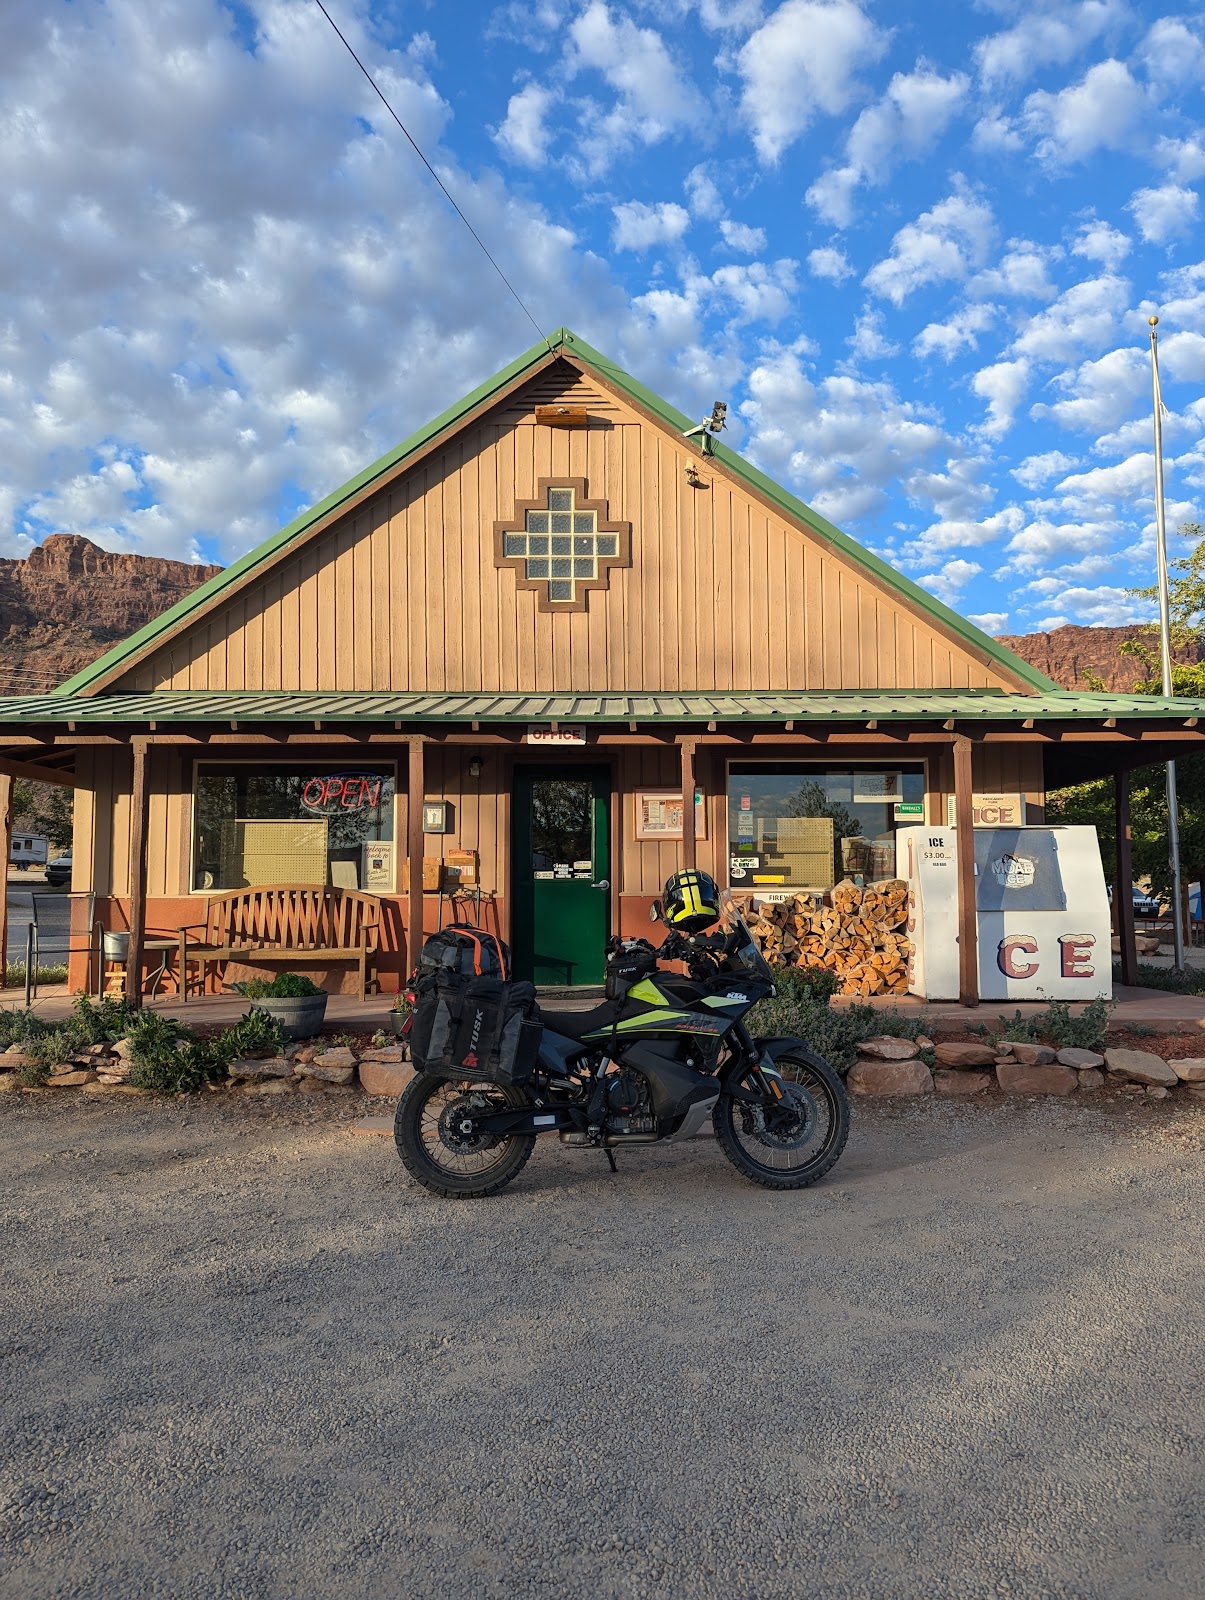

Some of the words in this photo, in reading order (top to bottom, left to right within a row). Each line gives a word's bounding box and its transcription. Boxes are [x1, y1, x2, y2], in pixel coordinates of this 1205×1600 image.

[533, 729, 581, 740] OFFICE
[303, 779, 381, 807] OPEN
[972, 805, 1014, 824] ICE
[928, 837, 945, 848] ICE
[991, 861, 1034, 874] MOAB
[726, 991, 747, 1001] KTM
[469, 1008, 484, 1051] TUSK
